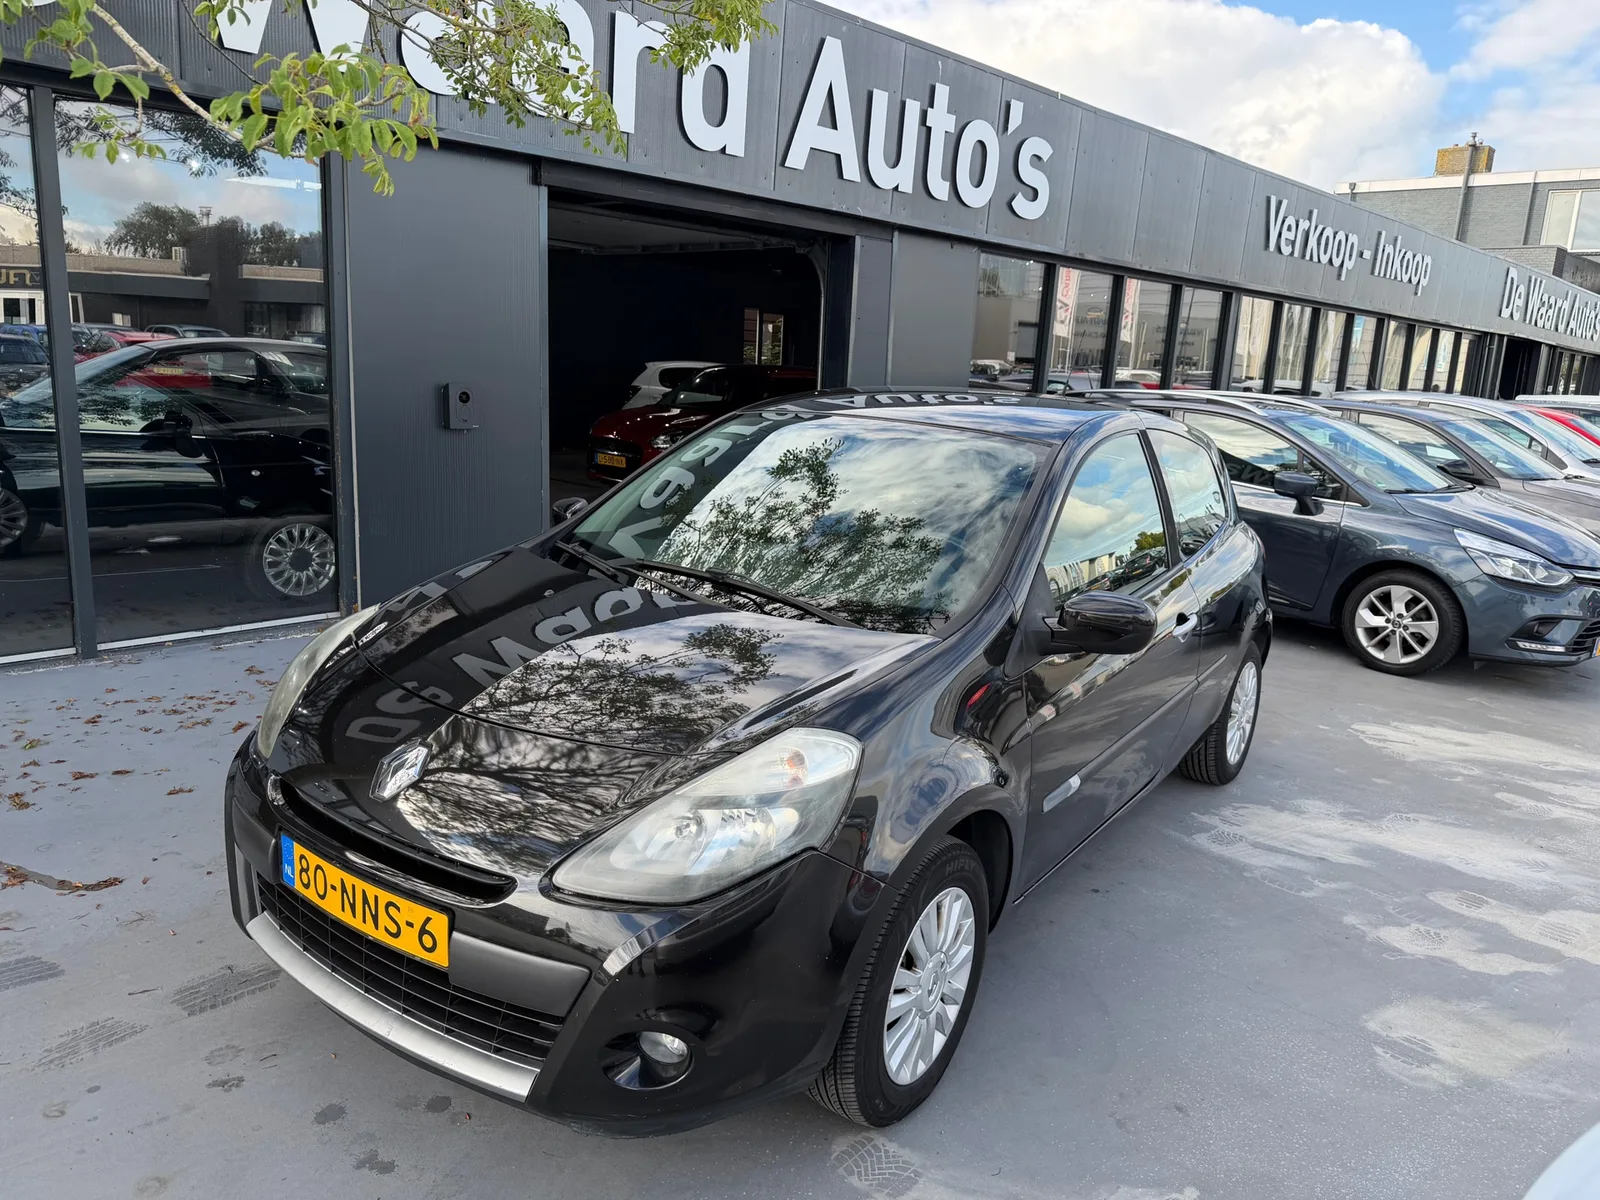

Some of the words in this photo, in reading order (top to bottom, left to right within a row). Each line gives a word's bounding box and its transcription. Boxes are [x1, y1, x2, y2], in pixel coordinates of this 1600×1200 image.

[784, 35, 1054, 221] Auto's
[1269, 194, 1359, 281] Verkoop
[1374, 230, 1432, 297] Inkoop
[1501, 266, 1525, 321] De
[1525, 275, 1572, 333] Waard
[284, 863, 294, 878] NL
[299, 853, 438, 954] 80-NNS-6
[945, 858, 978, 877] HIFLY
